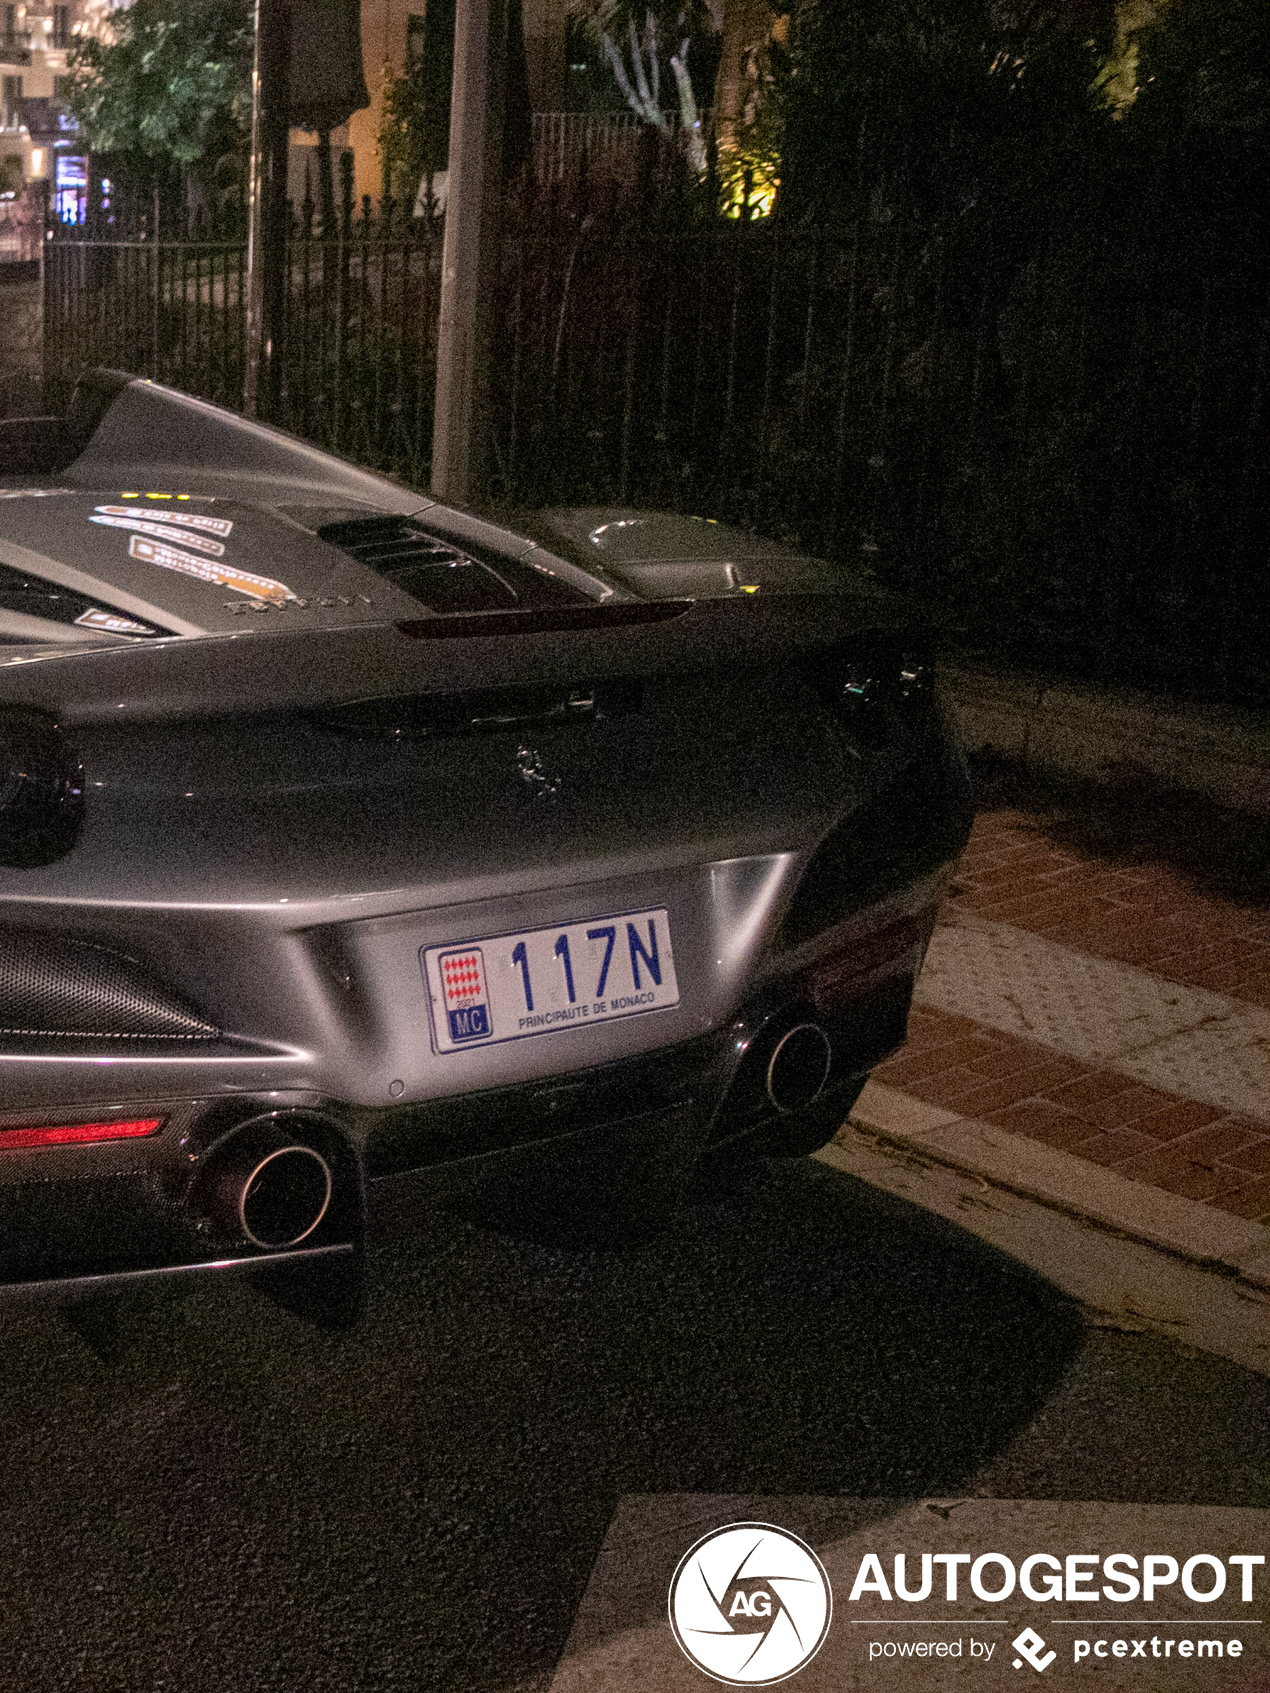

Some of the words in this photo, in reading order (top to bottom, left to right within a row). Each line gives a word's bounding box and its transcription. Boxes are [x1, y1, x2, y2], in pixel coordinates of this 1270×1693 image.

[512, 918, 662, 1011] 117N
[456, 1010, 482, 1034] MC
[518, 1005, 590, 1029] PRINCIPAUTE
[593, 1001, 607, 1014] DE
[611, 992, 655, 1011] MONACO
